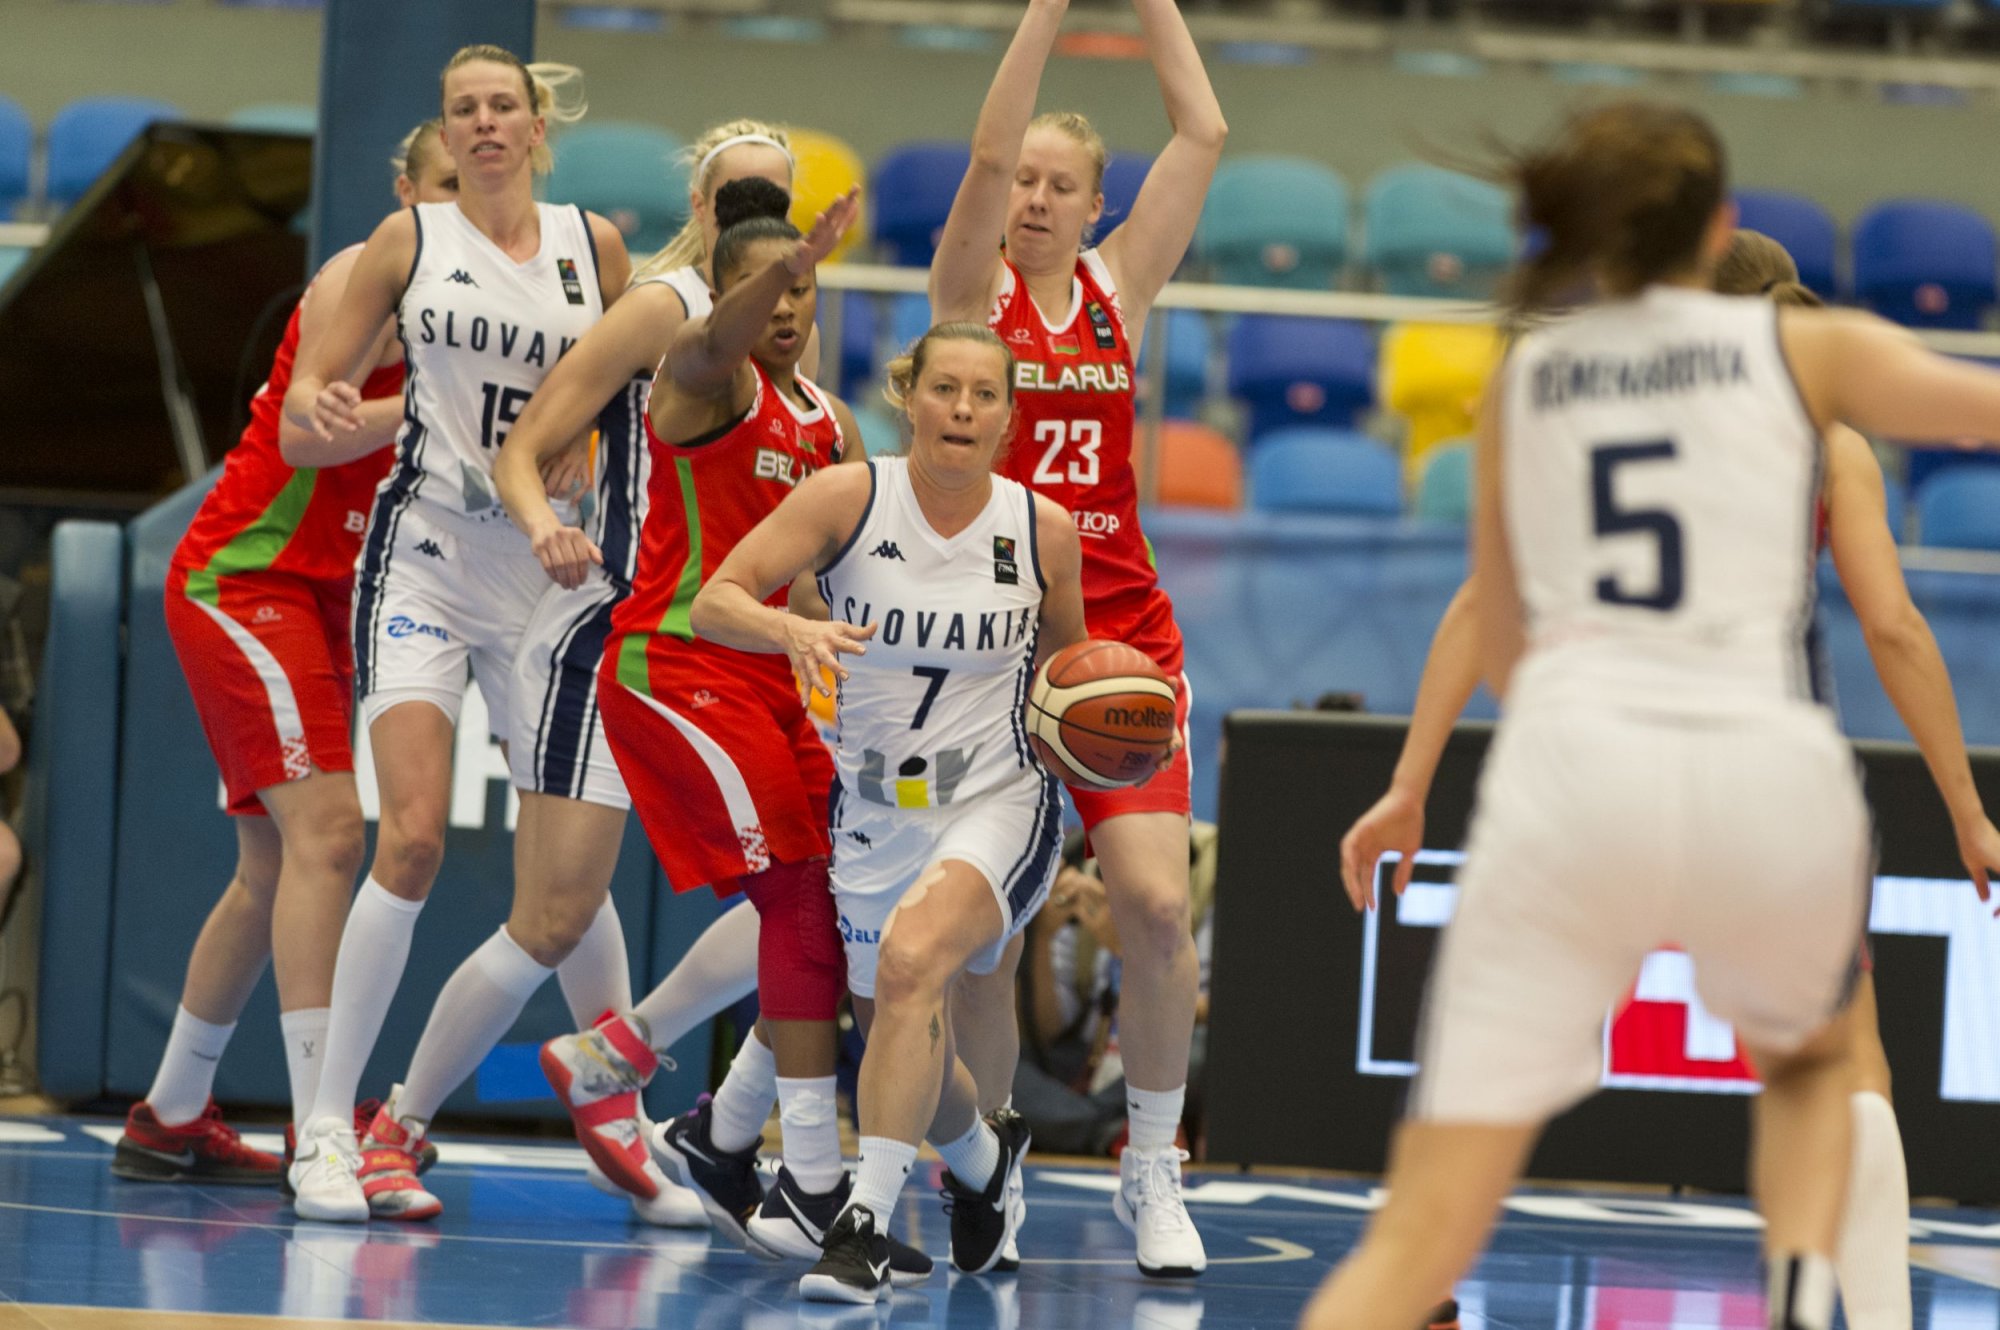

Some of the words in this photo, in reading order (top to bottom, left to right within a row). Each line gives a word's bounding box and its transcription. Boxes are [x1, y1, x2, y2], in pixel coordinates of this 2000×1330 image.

[1014, 361, 1130, 391] ELARUS
[1032, 419, 1103, 486] 23
[1589, 438, 1685, 612] 5
[909, 665, 950, 730] 7
